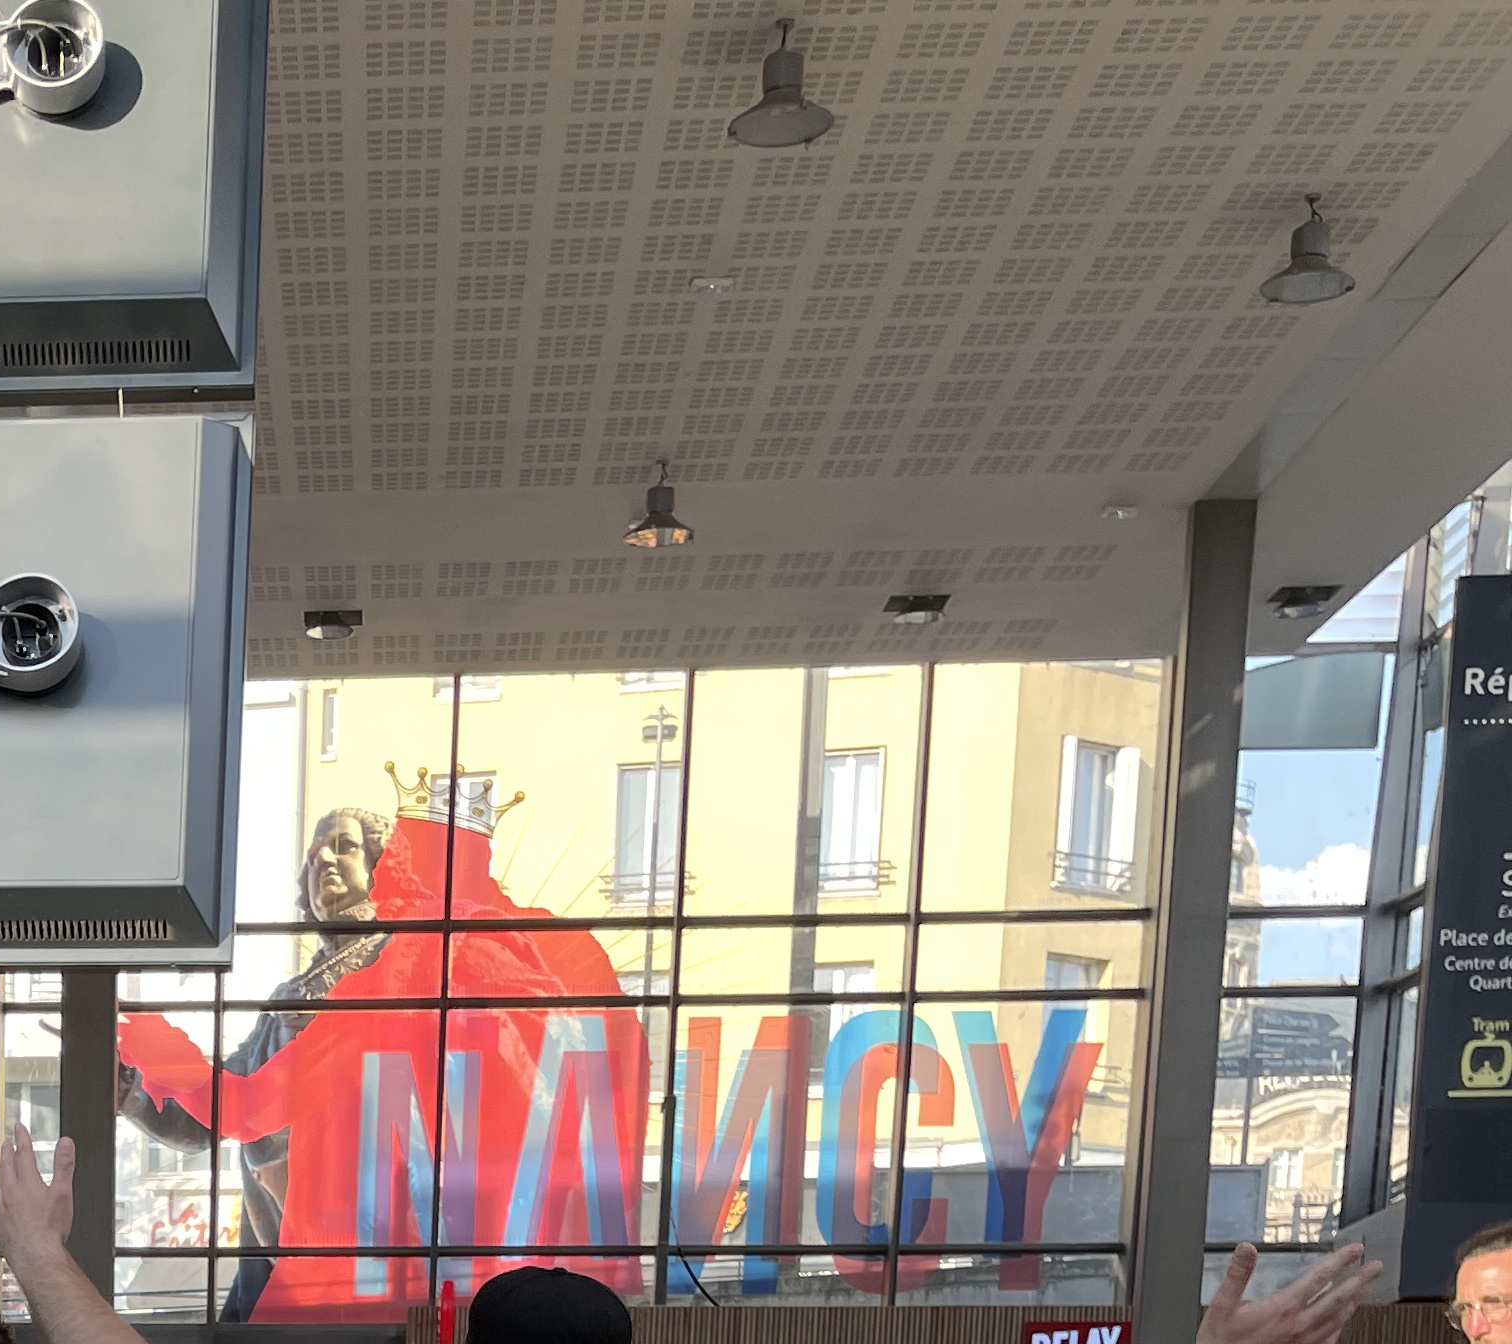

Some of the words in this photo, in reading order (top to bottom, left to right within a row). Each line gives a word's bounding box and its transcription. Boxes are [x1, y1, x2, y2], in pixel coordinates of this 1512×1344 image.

[1439, 929, 1488, 947] Place
[1444, 955, 1496, 972] Centre
[1470, 1016, 1510, 1033] Tram
